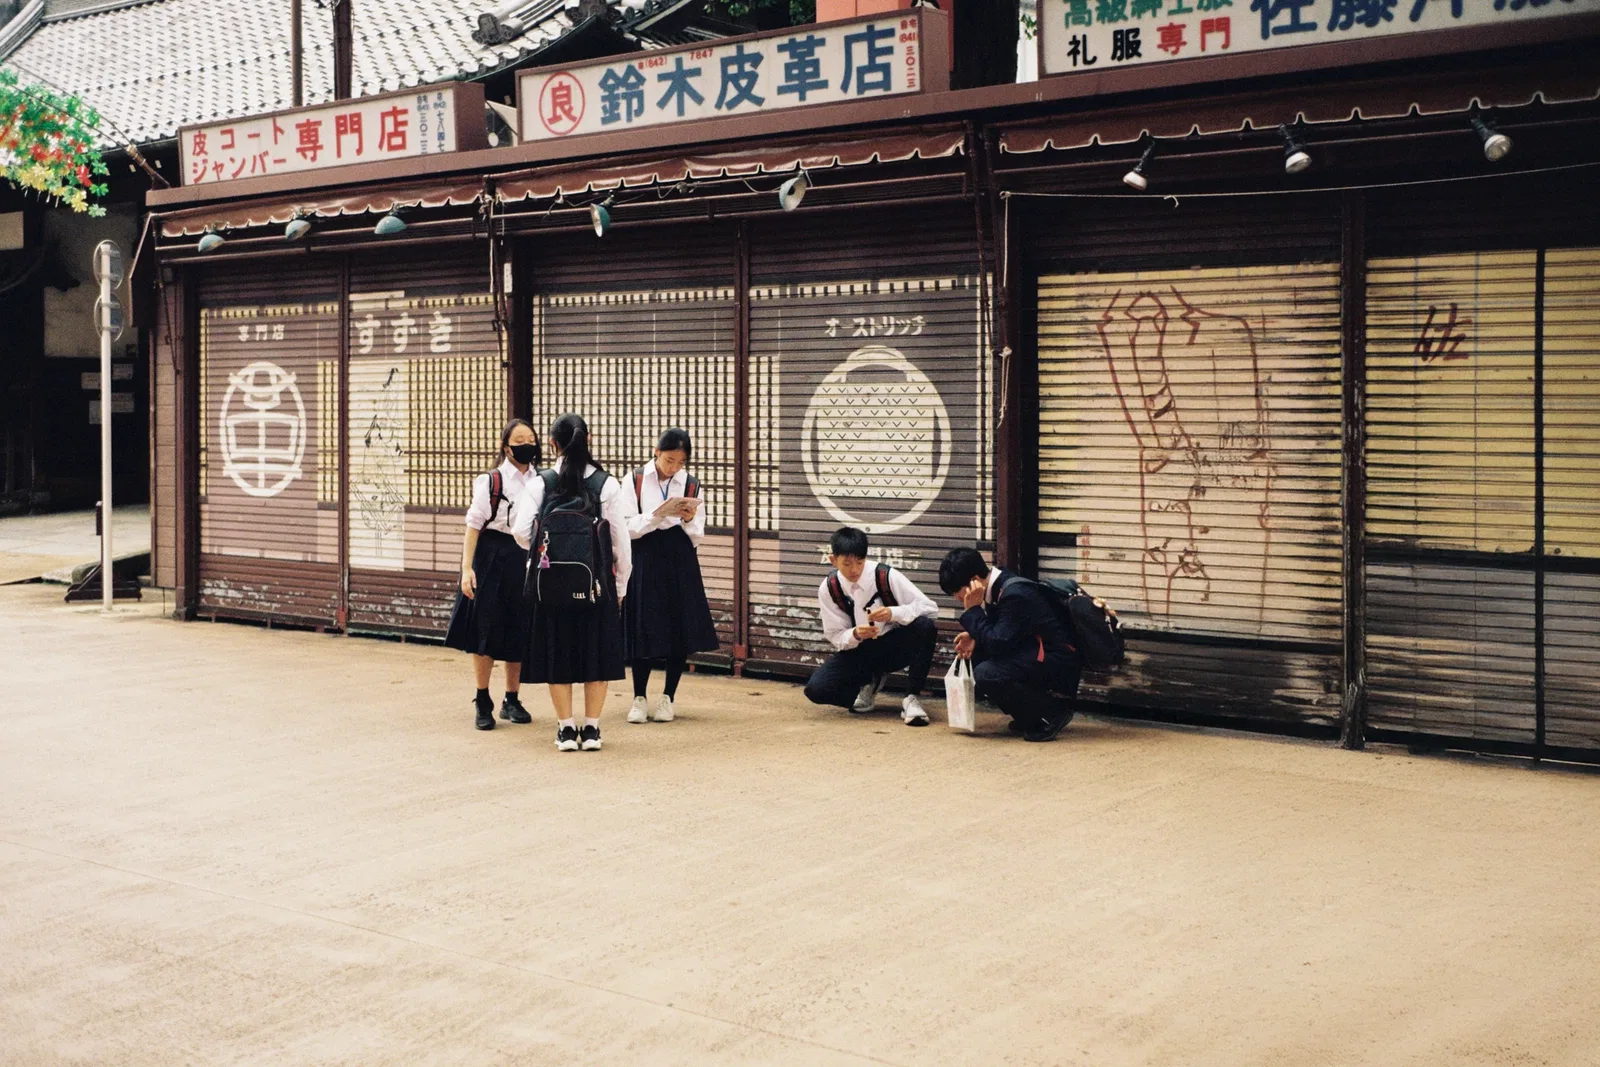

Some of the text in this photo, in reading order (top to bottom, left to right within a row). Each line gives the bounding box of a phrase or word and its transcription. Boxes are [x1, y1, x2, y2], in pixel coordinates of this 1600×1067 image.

[689, 48, 714, 61] 7847
[1067, 16, 1231, 67] 礼服専門
[598, 24, 896, 126] 鈴木皮革店
[192, 117, 284, 156] 皮コート
[295, 106, 409, 163] 専門店
[355, 310, 452, 354] すずき
[824, 315, 926, 337] オーストリッチ
